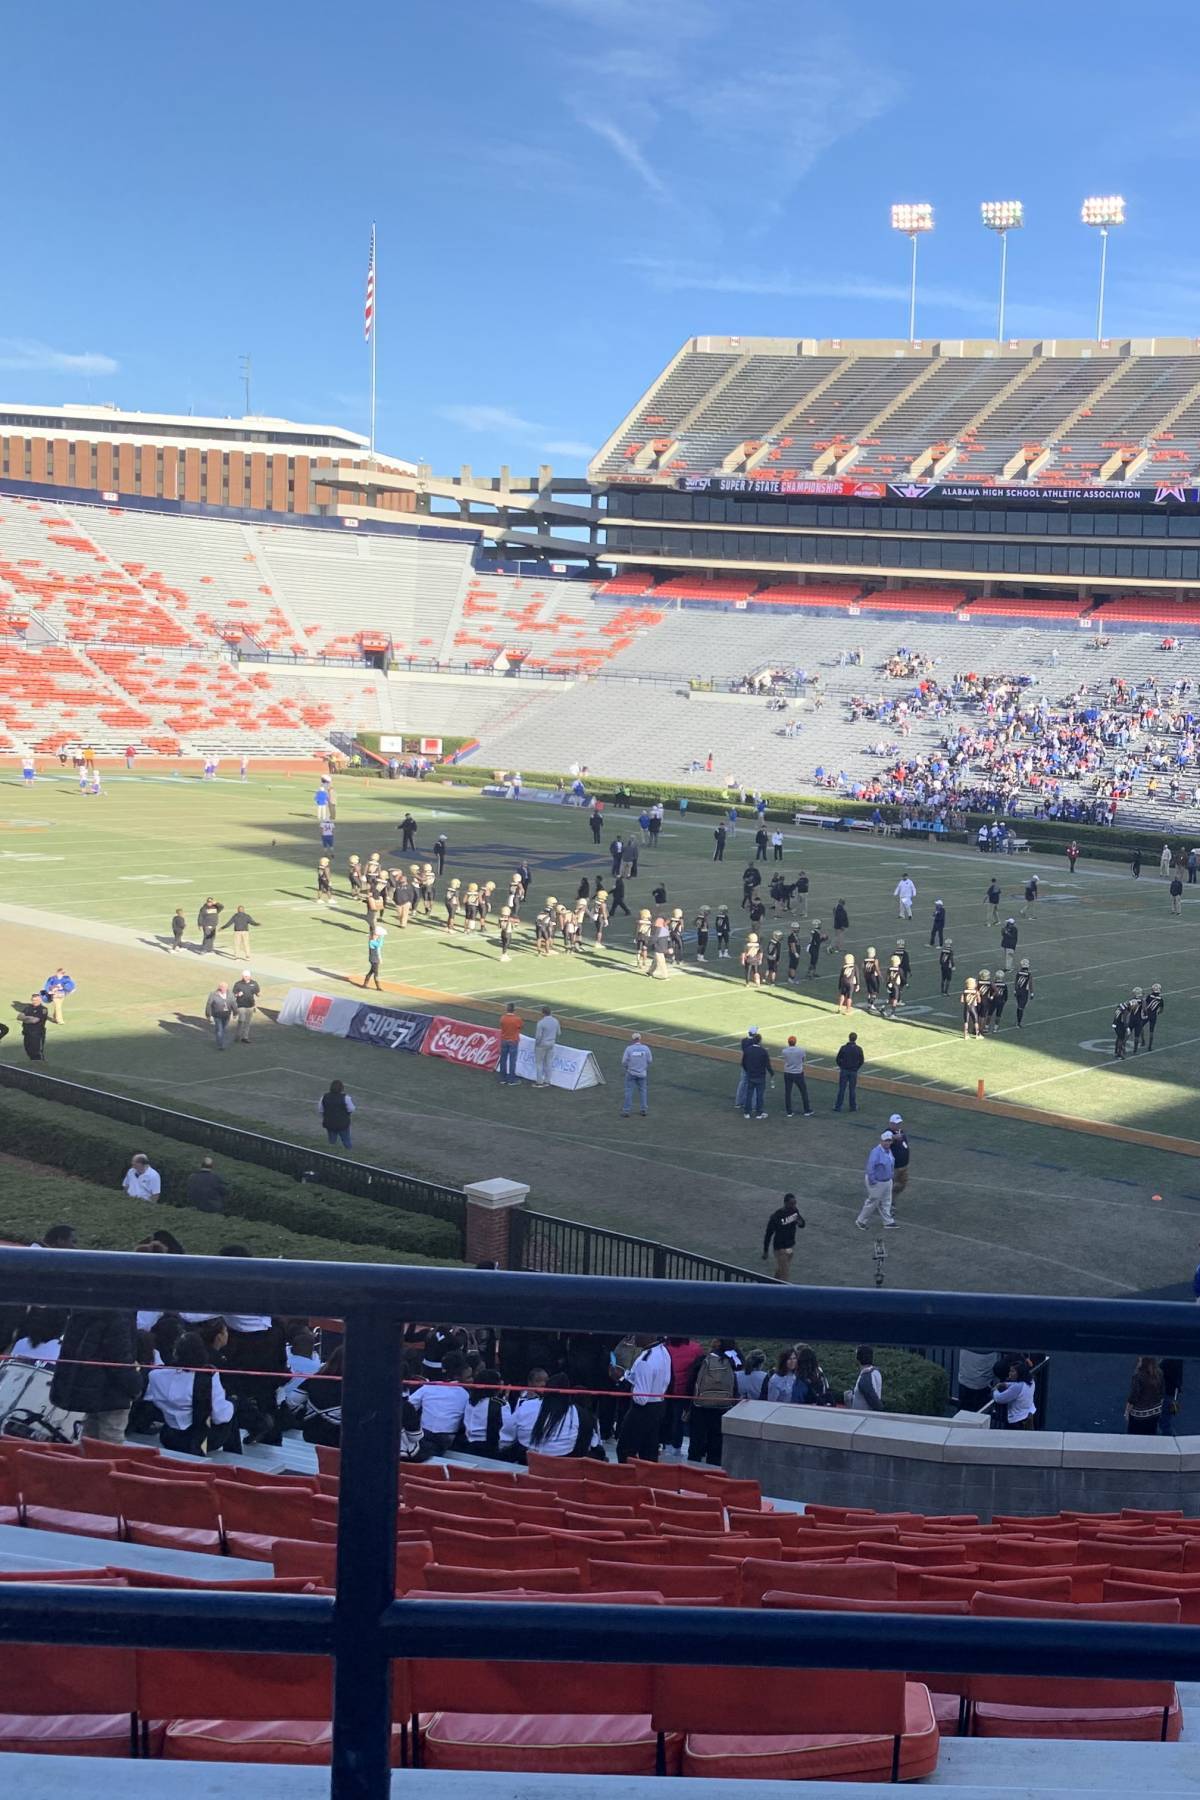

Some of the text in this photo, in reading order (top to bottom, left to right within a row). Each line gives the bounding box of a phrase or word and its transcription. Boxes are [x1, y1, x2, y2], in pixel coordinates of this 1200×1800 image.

[720, 479, 746, 491] SUPER
[748, 481, 754, 492] 7
[755, 481, 780, 492] STATE
[781, 481, 844, 494] CHAMPIONSHIPS
[942, 488, 1141, 499] ALABAMA HIGH SCHOOL ATHLETIC ASSOCIATION
